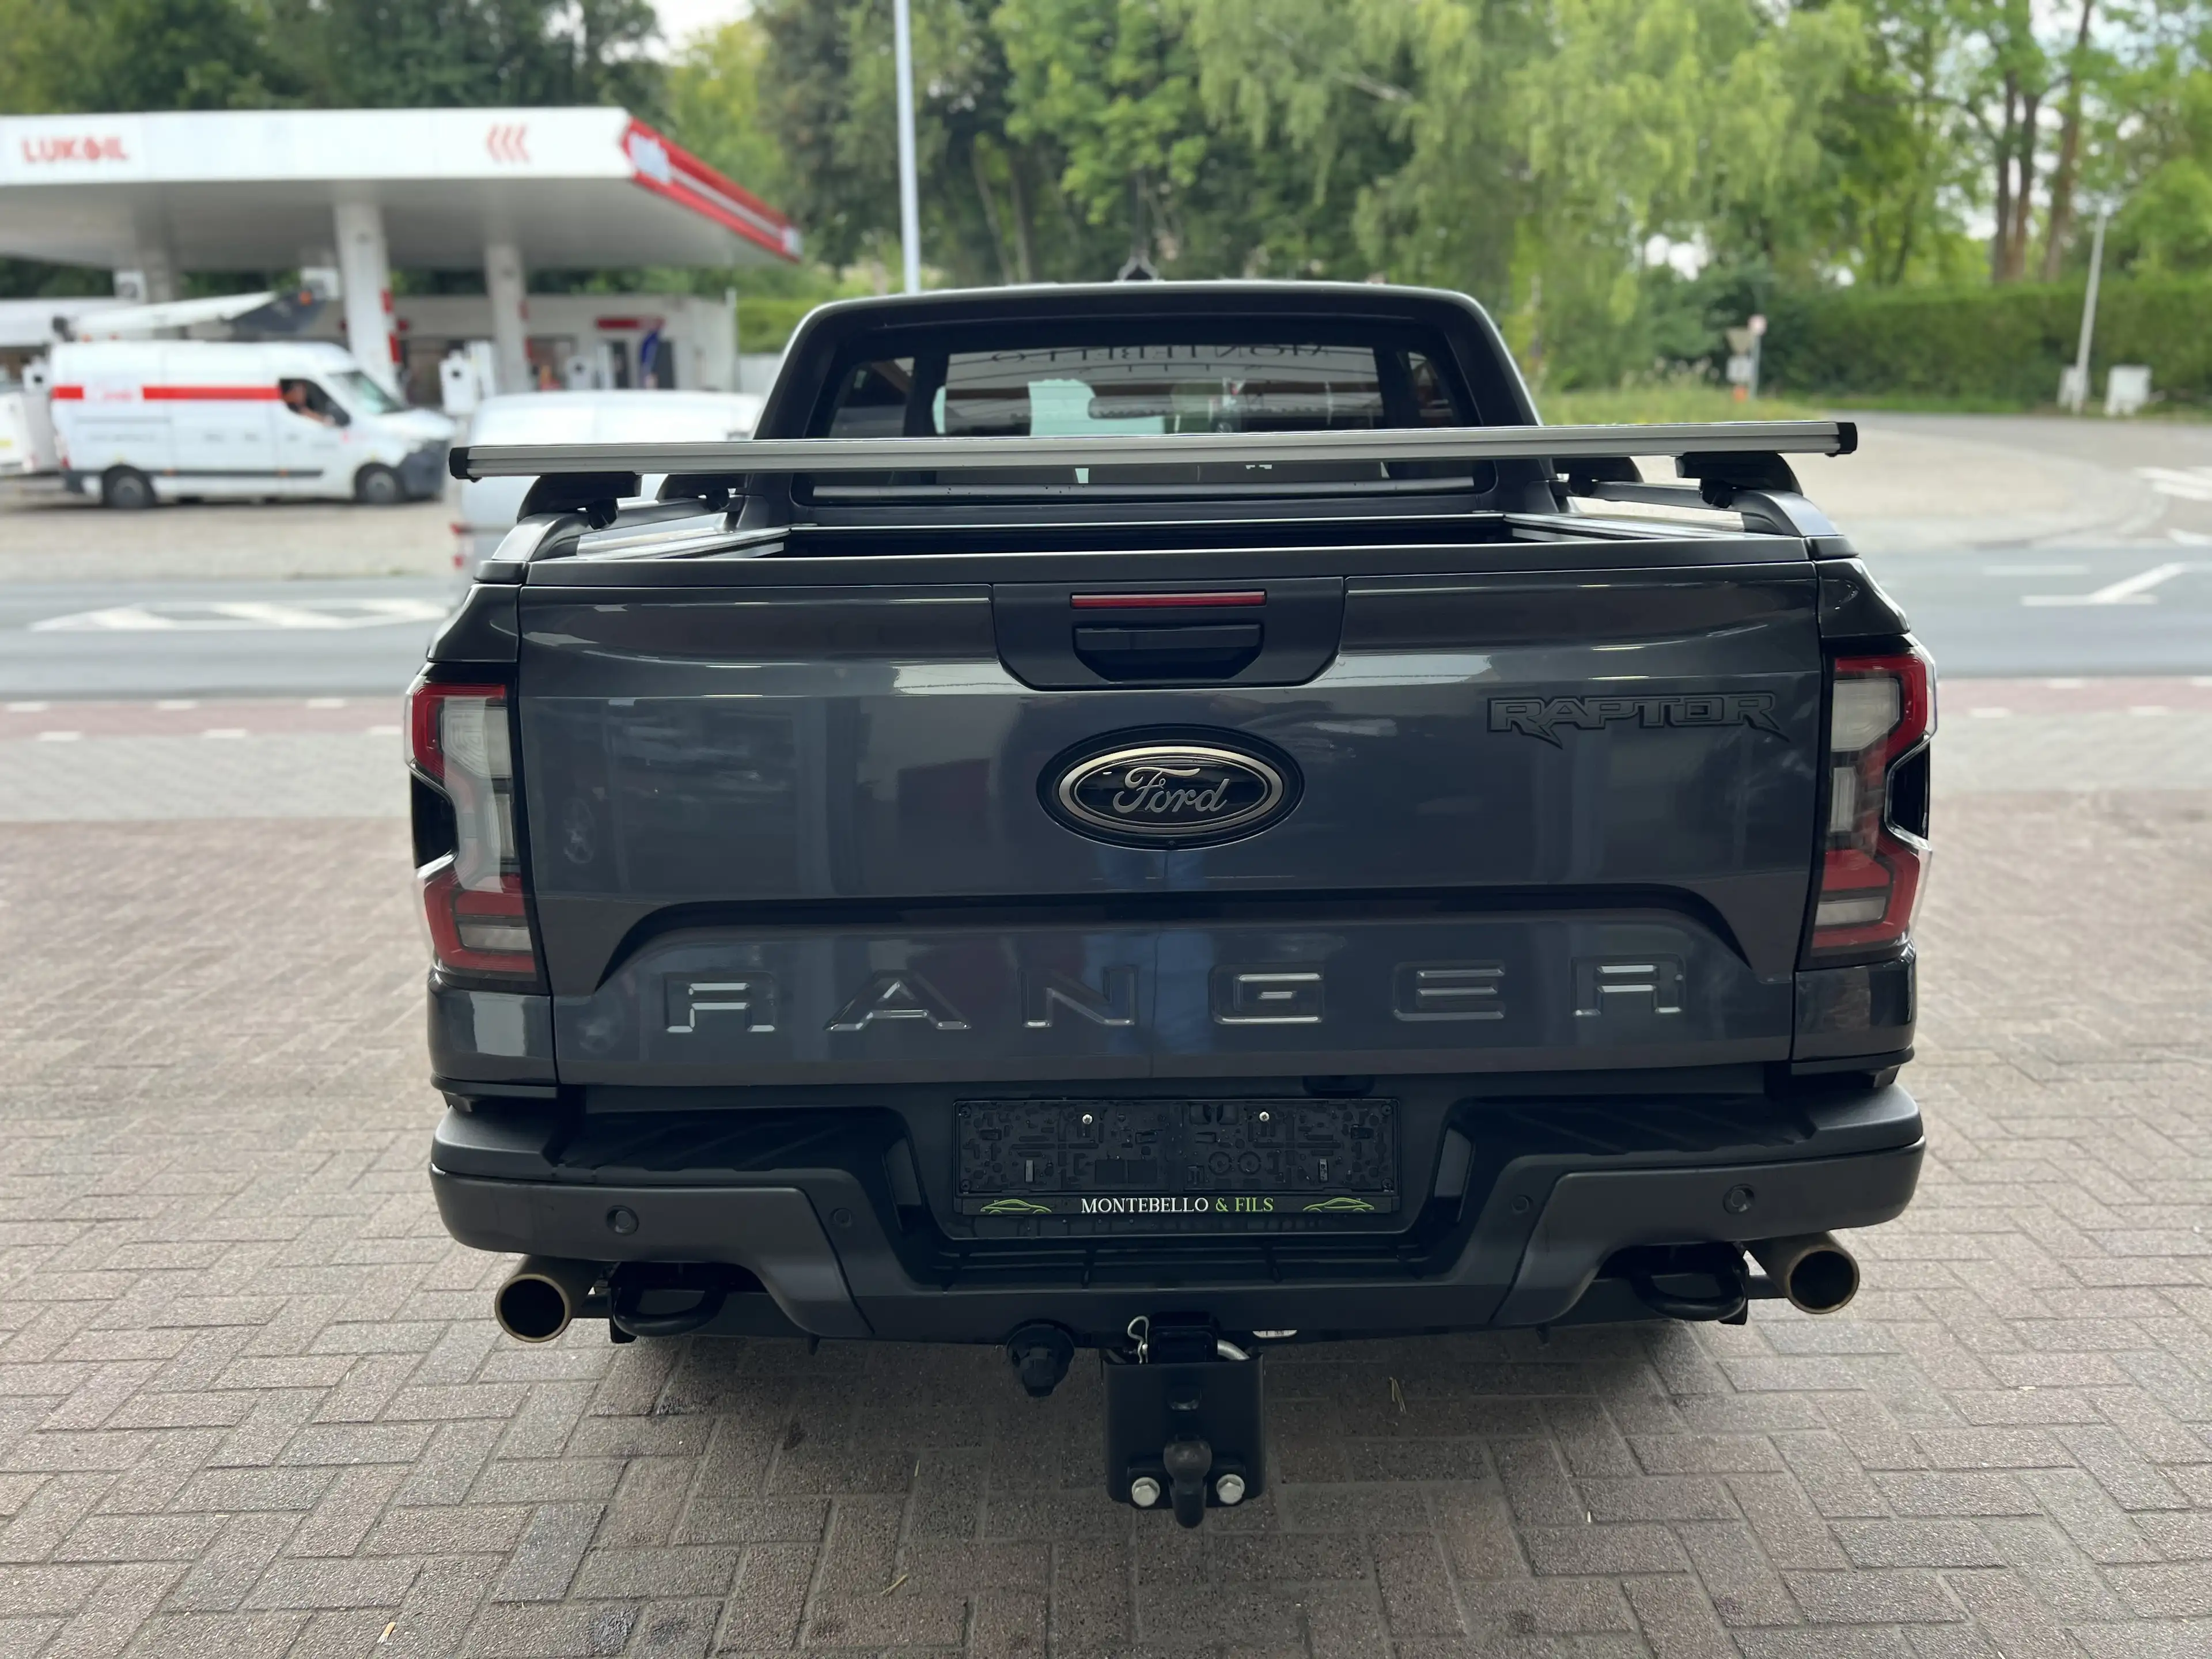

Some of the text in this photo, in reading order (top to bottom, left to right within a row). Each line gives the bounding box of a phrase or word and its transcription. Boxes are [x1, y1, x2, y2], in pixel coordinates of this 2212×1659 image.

[21, 136, 129, 164] LUKOIL
[1487, 691, 1790, 749] RAPTOR
[1112, 766, 1230, 813] Ford
[664, 953, 1685, 1034] RANGER
[1081, 1197, 1274, 1213] MONTEBELLO & FILS
